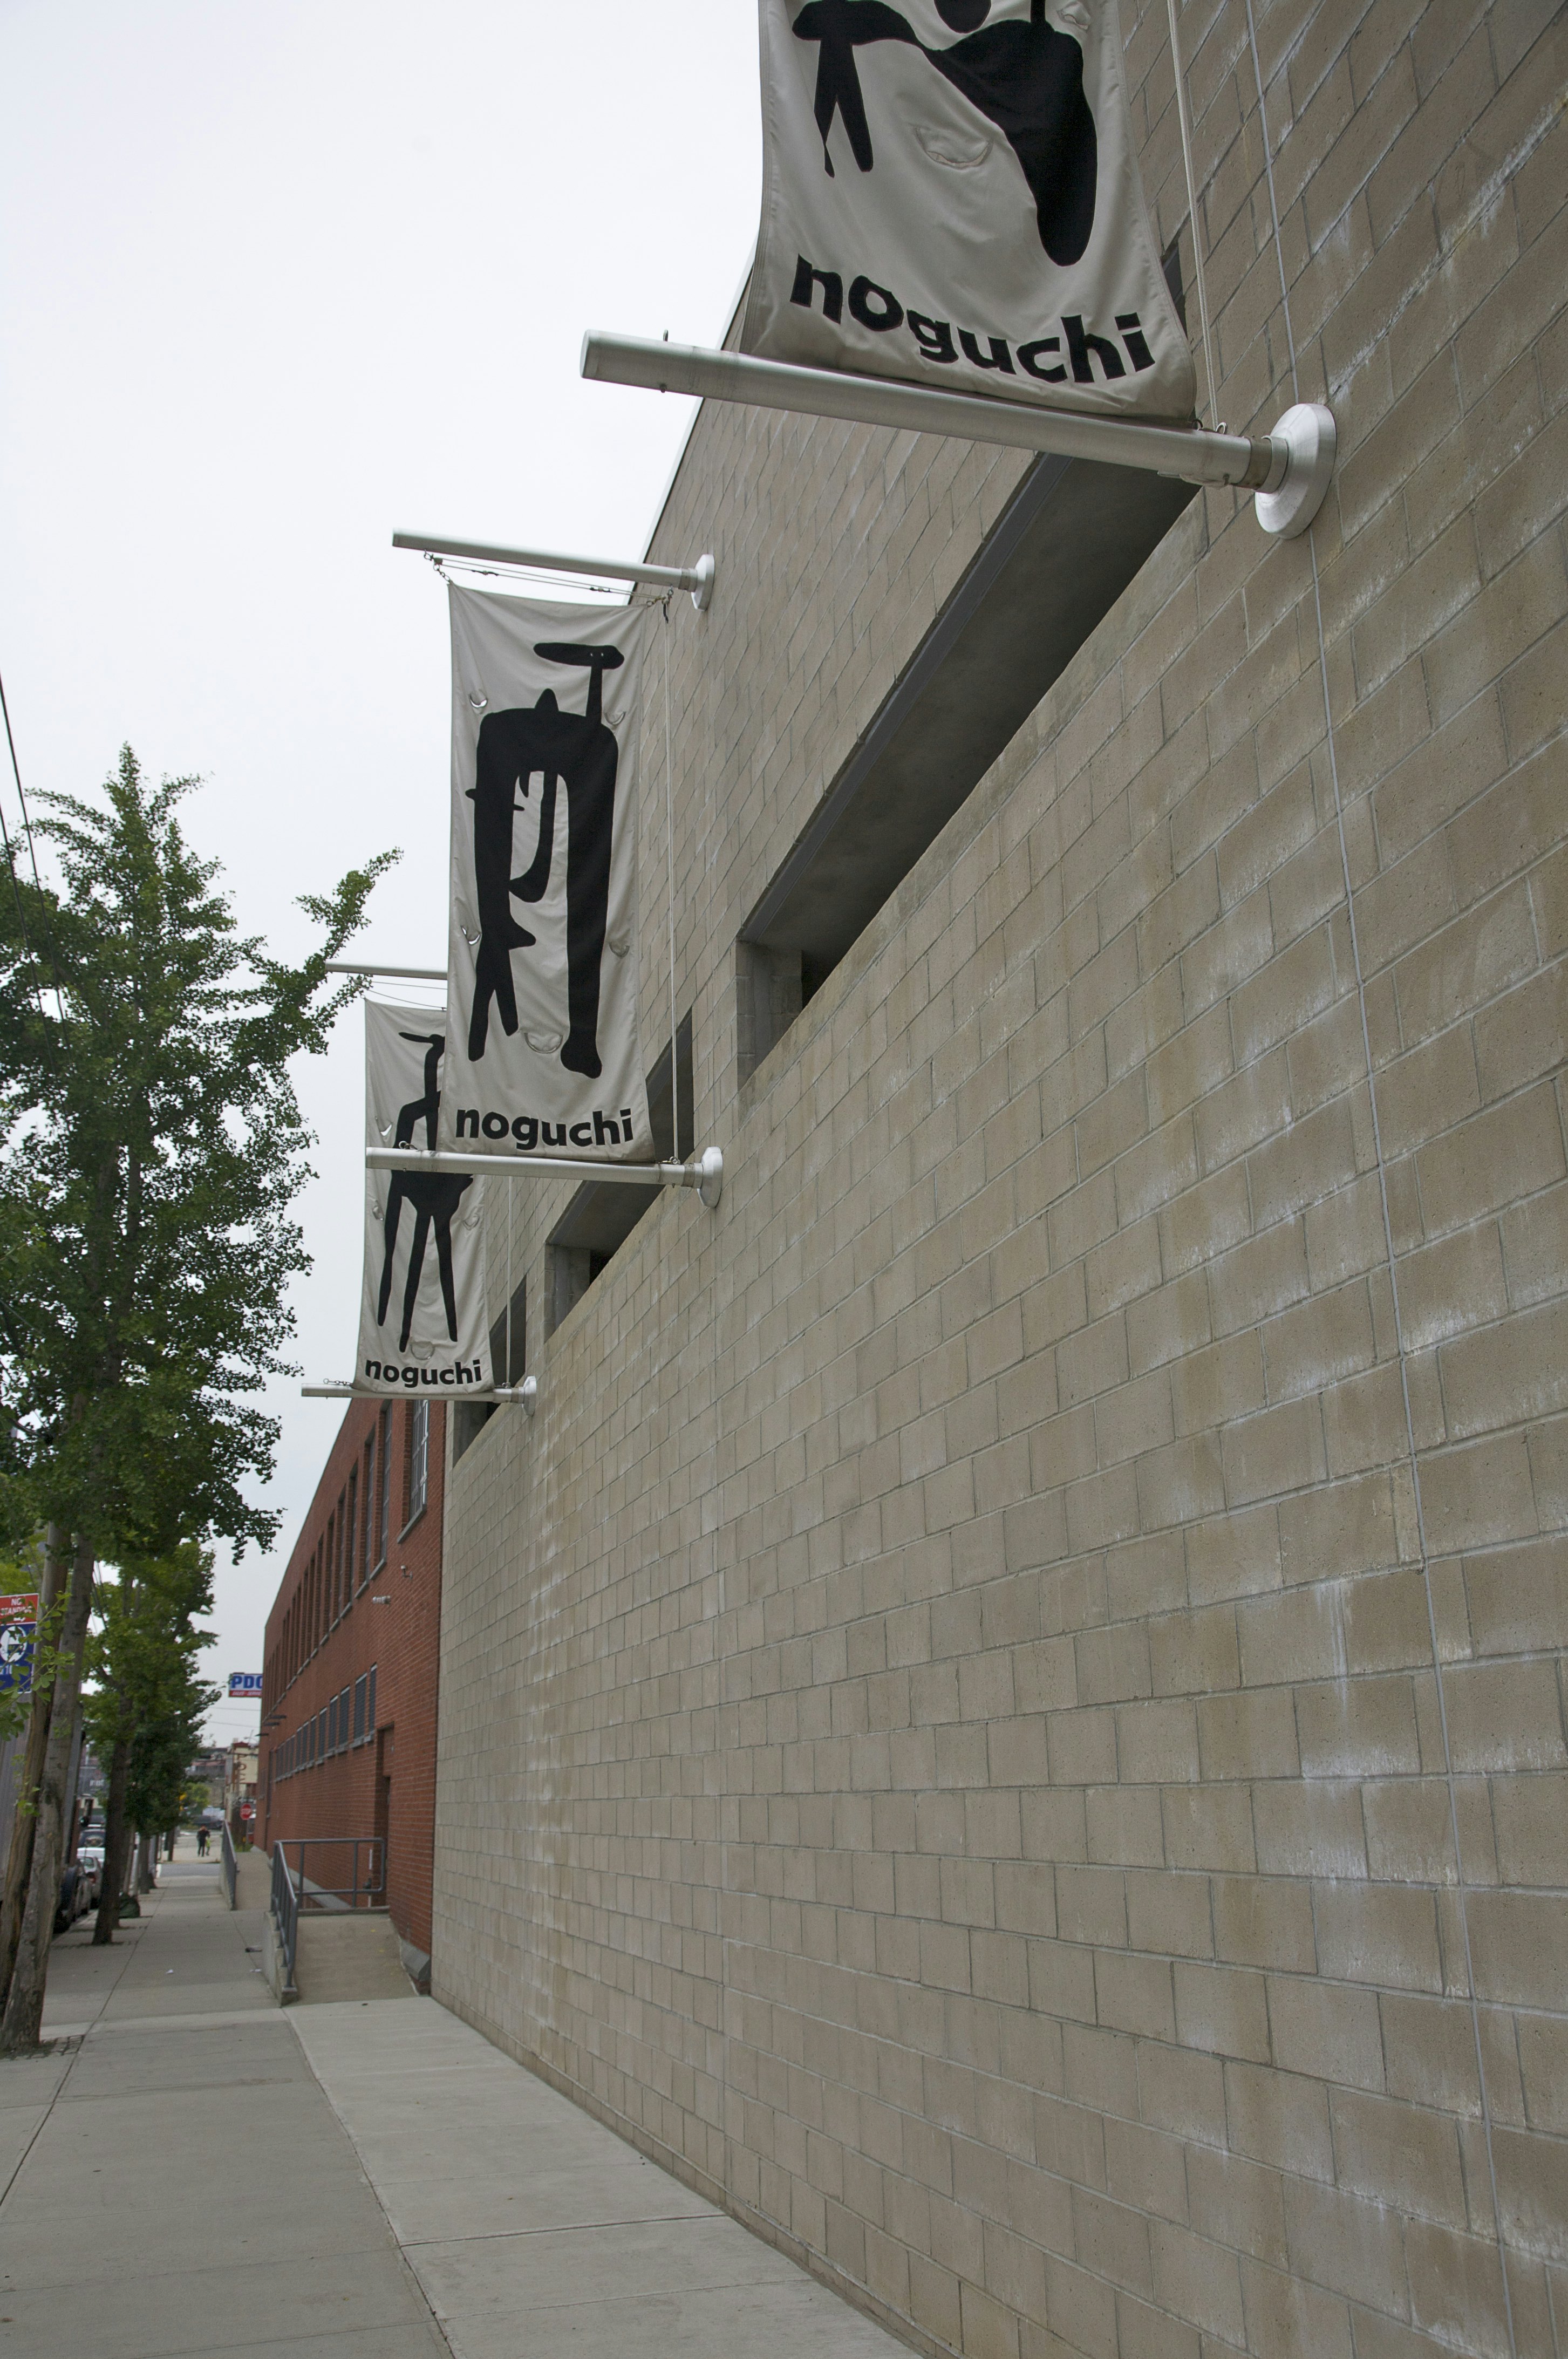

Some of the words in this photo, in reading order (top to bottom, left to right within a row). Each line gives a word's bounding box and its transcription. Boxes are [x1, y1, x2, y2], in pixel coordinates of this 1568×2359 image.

[790, 254, 1155, 383] noguchi
[455, 1108, 633, 1150] noguchi
[365, 1359, 482, 1388] noguchi
